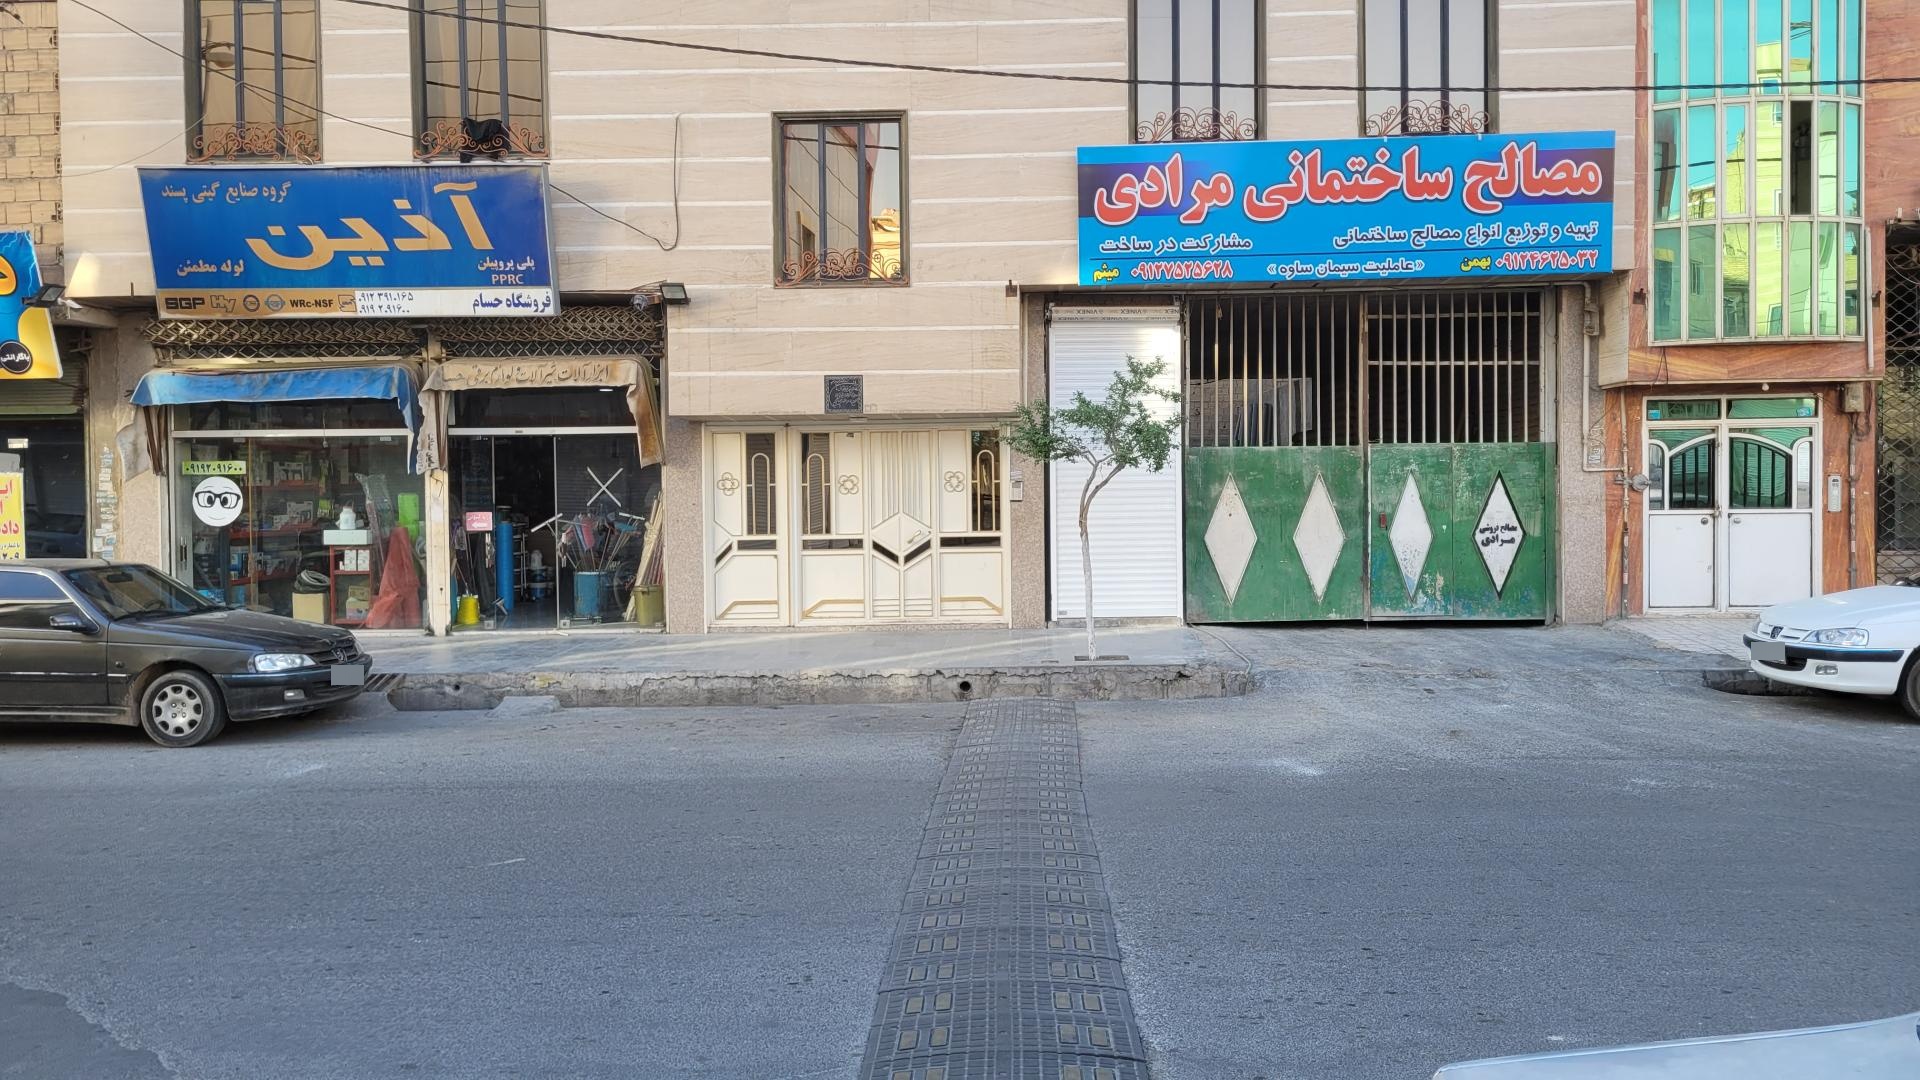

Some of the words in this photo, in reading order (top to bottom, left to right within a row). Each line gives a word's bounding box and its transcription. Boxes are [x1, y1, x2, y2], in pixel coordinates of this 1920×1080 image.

[1244, 145, 1454, 222] ساختمانی
[1463, 141, 1603, 214] مصالح
[161, 185, 188, 203] پسند
[192, 181, 220, 203] گیتی
[225, 182, 258, 204] صنایع
[262, 181, 292, 202] گروه
[1093, 152, 1234, 225] مرادی
[245, 181, 495, 271] آذین
[1465, 222, 1501, 246] انواع
[1504, 223, 1547, 246] توزیع
[1551, 227, 1561, 241] و
[1565, 221, 1599, 241] تهیه
[1100, 234, 1152, 253] ساخت
[1181, 232, 1252, 256] مشارکت
[1333, 227, 1407, 249] ساختمانی
[1411, 225, 1461, 247] مصالح
[1155, 239, 1176, 256] در
[176, 258, 217, 277] مطمئن
[221, 258, 245, 277] لوله
[477, 255, 515, 271] پروپیلن
[516, 255, 536, 271] پلی
[1316, 260, 1360, 278] سیمان
[1460, 256, 1491, 272] بهمن
[1495, 249, 1599, 271] ۰۹۱۲۴۶۲۵۰۳۲
[491, 274, 524, 285] PPRC
[1093, 263, 1120, 282] میثم
[1131, 260, 1233, 280] ۰۹۱۲۷۵۲۵۶۲۸
[289, 299, 334, 308] WRc-NSF
[472, 292, 503, 314] حسام
[505, 291, 551, 313] فروشگاه
[185, 463, 243, 473] ۰۹۱۹۲۰۹۱۶۰۰
[1479, 523, 1500, 534] فروشی
[1500, 522, 1518, 534] مصالح
[1481, 533, 1516, 547] مرادی
